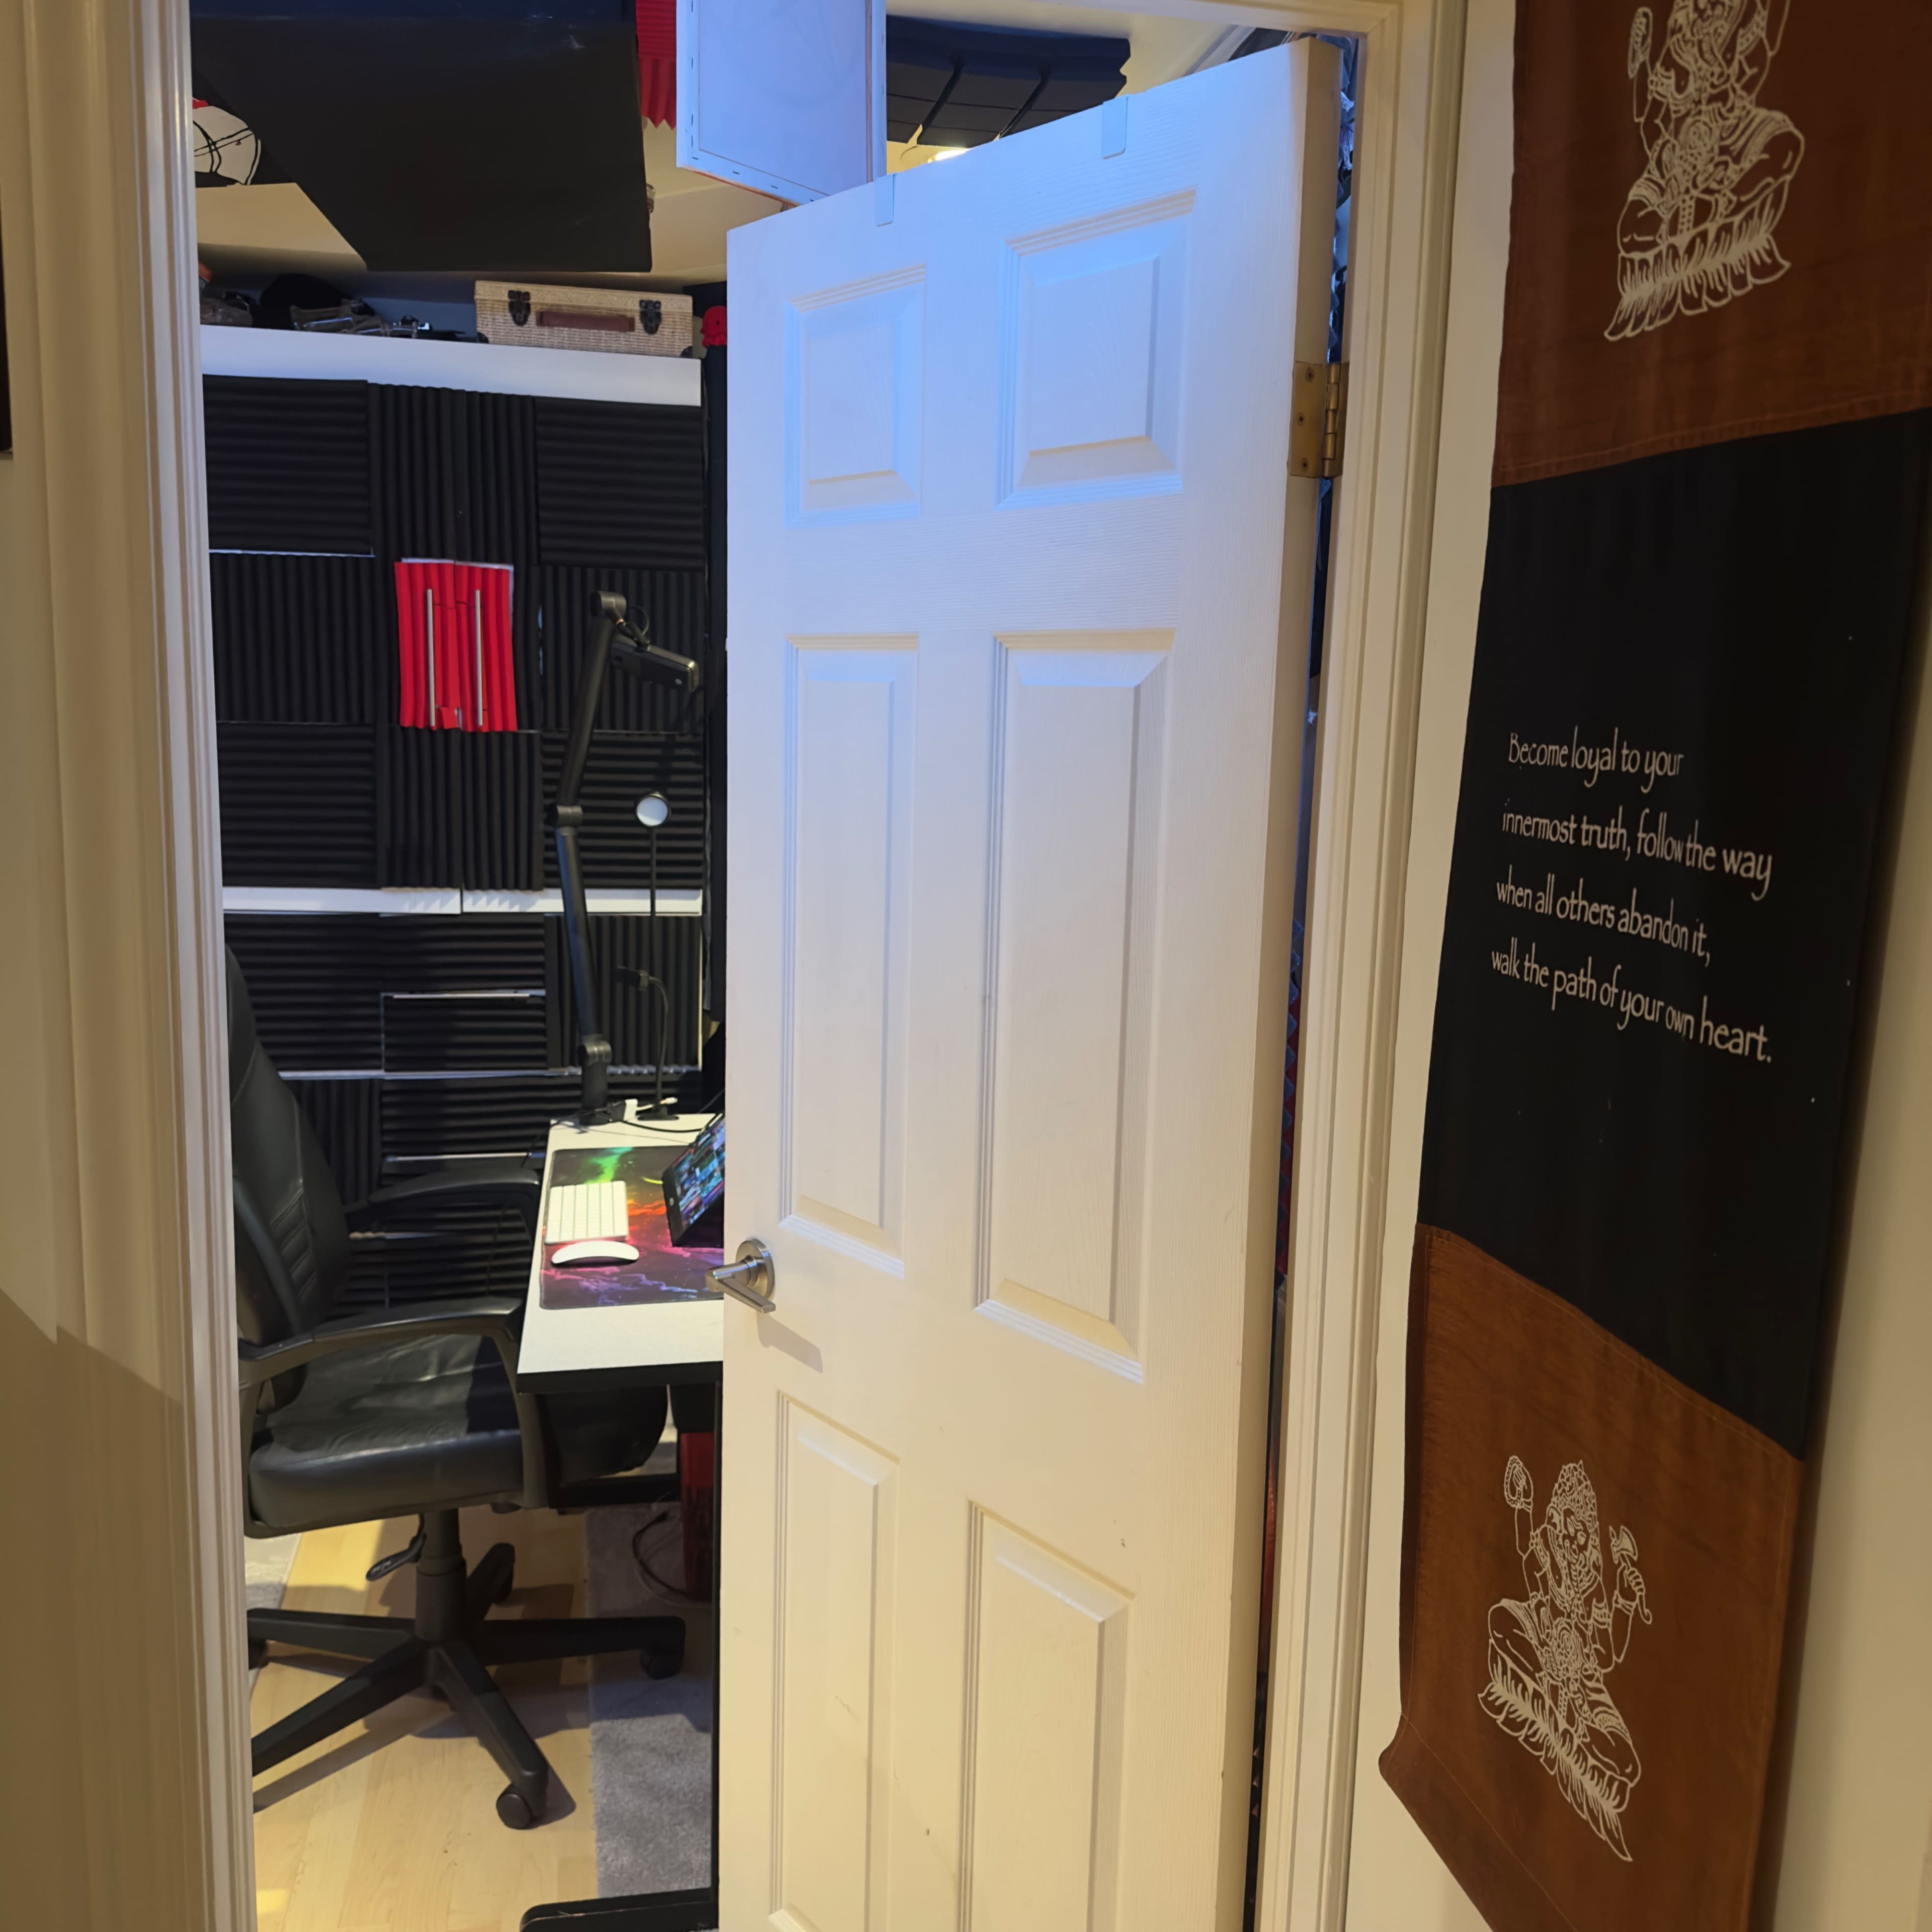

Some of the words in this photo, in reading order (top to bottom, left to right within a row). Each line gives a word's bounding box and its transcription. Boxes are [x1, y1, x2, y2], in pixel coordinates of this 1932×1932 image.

[1509, 733, 1568, 768] Become
[1571, 726, 1619, 788] loyal
[1621, 741, 1640, 773] to
[1640, 751, 1684, 793] your
[1502, 805, 1578, 845] innermost
[1580, 805, 1631, 861] truth,
[1637, 808, 1684, 862] follow
[1685, 820, 1716, 871] the
[1722, 849, 1772, 901] way
[1496, 864, 1533, 910] when
[1535, 873, 1555, 915] all
[1556, 877, 1616, 928] others
[1617, 888, 1688, 951] abandon
[1692, 919, 1710, 967] it,
[1491, 936, 1520, 979] walk
[1523, 942, 1549, 988] the
[1551, 956, 1597, 1011] path
[1599, 964, 1622, 1008] of
[1617, 990, 1665, 1030] your
[1665, 1006, 1695, 1040] own
[1700, 995, 1772, 1063] heart.
